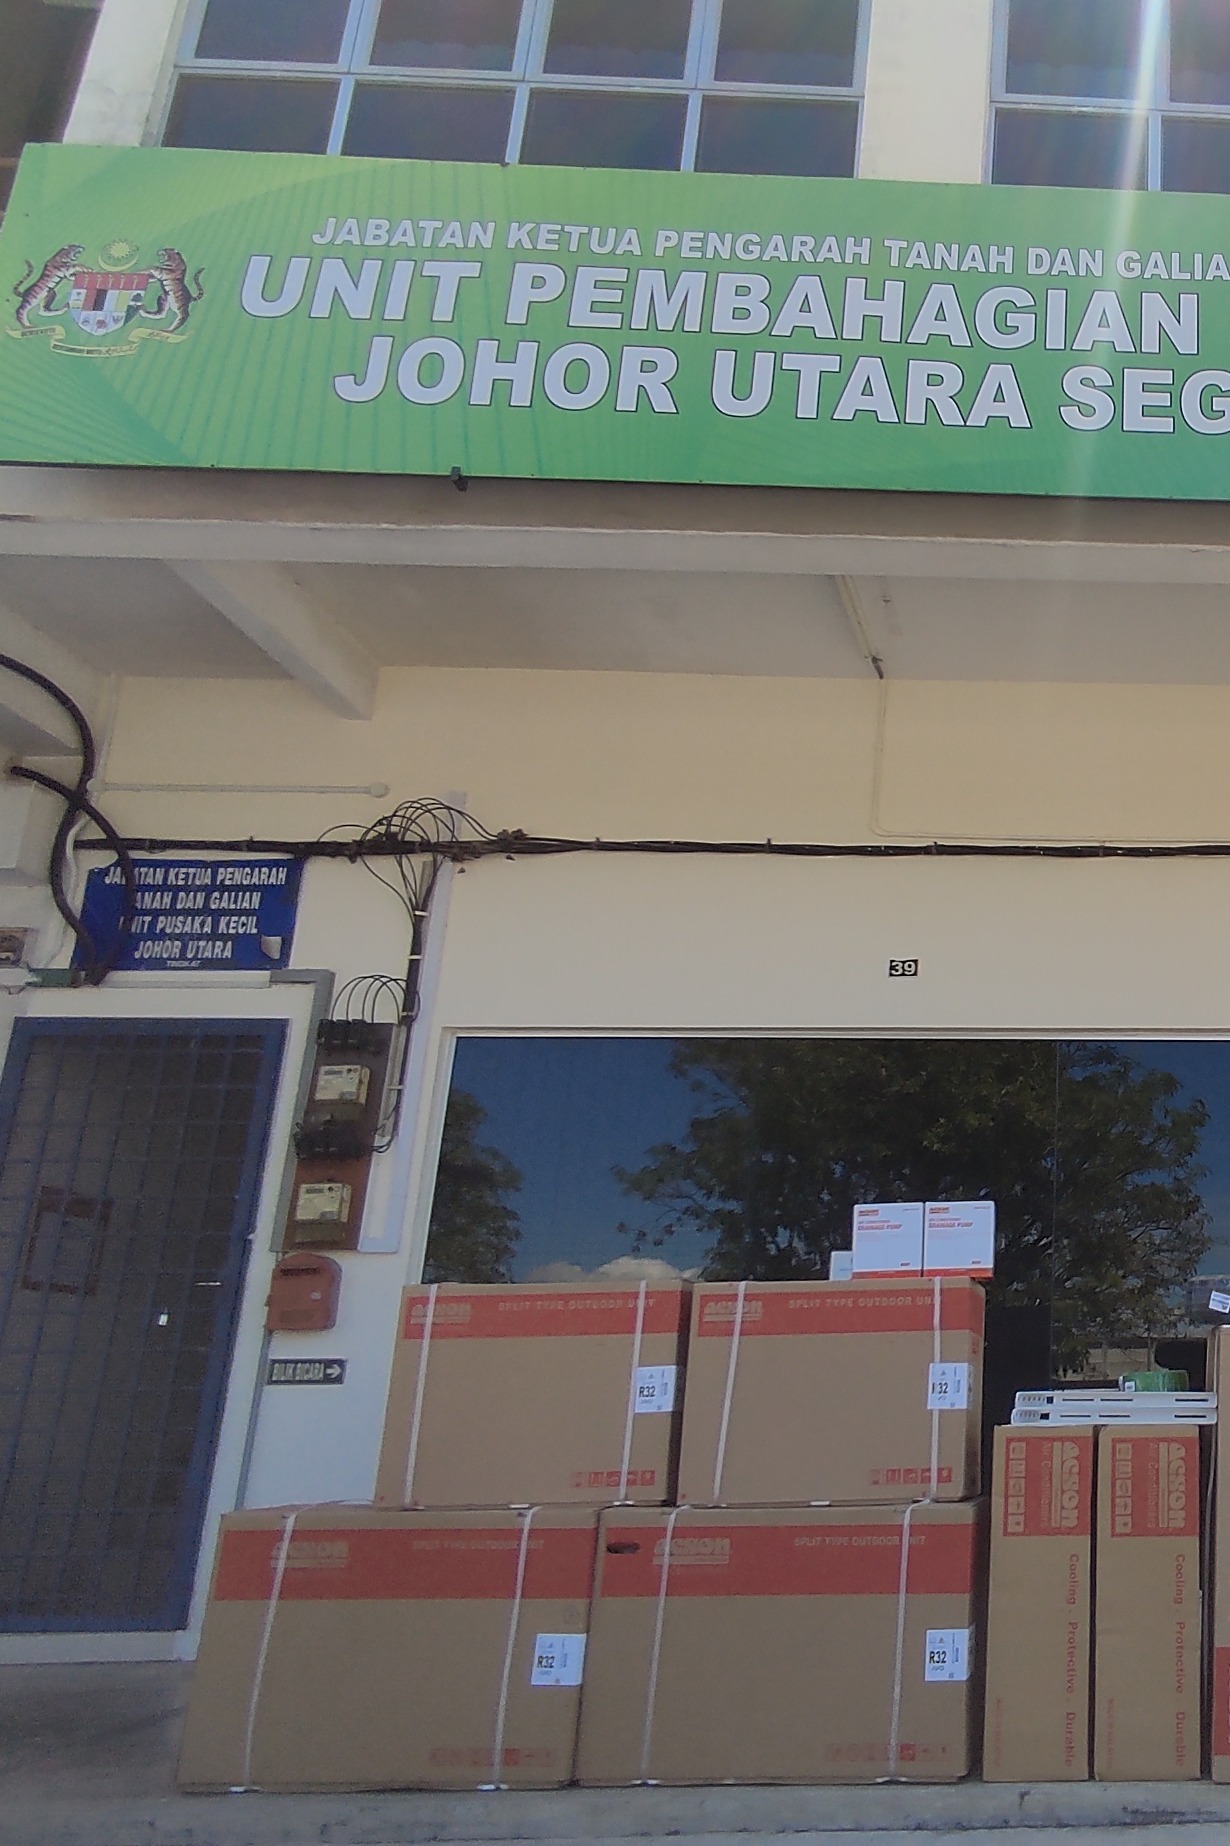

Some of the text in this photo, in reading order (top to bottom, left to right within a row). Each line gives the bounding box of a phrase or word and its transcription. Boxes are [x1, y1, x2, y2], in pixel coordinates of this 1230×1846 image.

[310, 216, 497, 251] JABATAN
[505, 221, 641, 256] KETUA
[653, 228, 872, 266] PENGARAH
[884, 237, 1015, 275] TANAH
[1027, 245, 1105, 278] DAN
[239, 254, 482, 323] UNIT
[505, 258, 1199, 356] PEMBAHAGIAN
[333, 335, 680, 415] JOHOR
[711, 350, 1033, 430] UTARA
[105, 867, 288, 885] JATAN KETUA PENGARAH
[135, 892, 262, 910] ANAH DAN GALIAN
[156, 916, 212, 934] PUSAKA
[218, 916, 259, 934] KECIL
[134, 940, 233, 959] JOHOR UTARA
[890, 960, 917, 976] 39
[536, 1300, 564, 1311] TYPE
[825, 1297, 854, 1308] TYPE
[638, 1385, 656, 1398] R32
[537, 1655, 555, 1669] R32
[929, 1650, 947, 1664] R32
[1064, 1553, 1080, 1768] Cooling Protective Durable
[1173, 1553, 1186, 1767] Cooling Protective Durable
